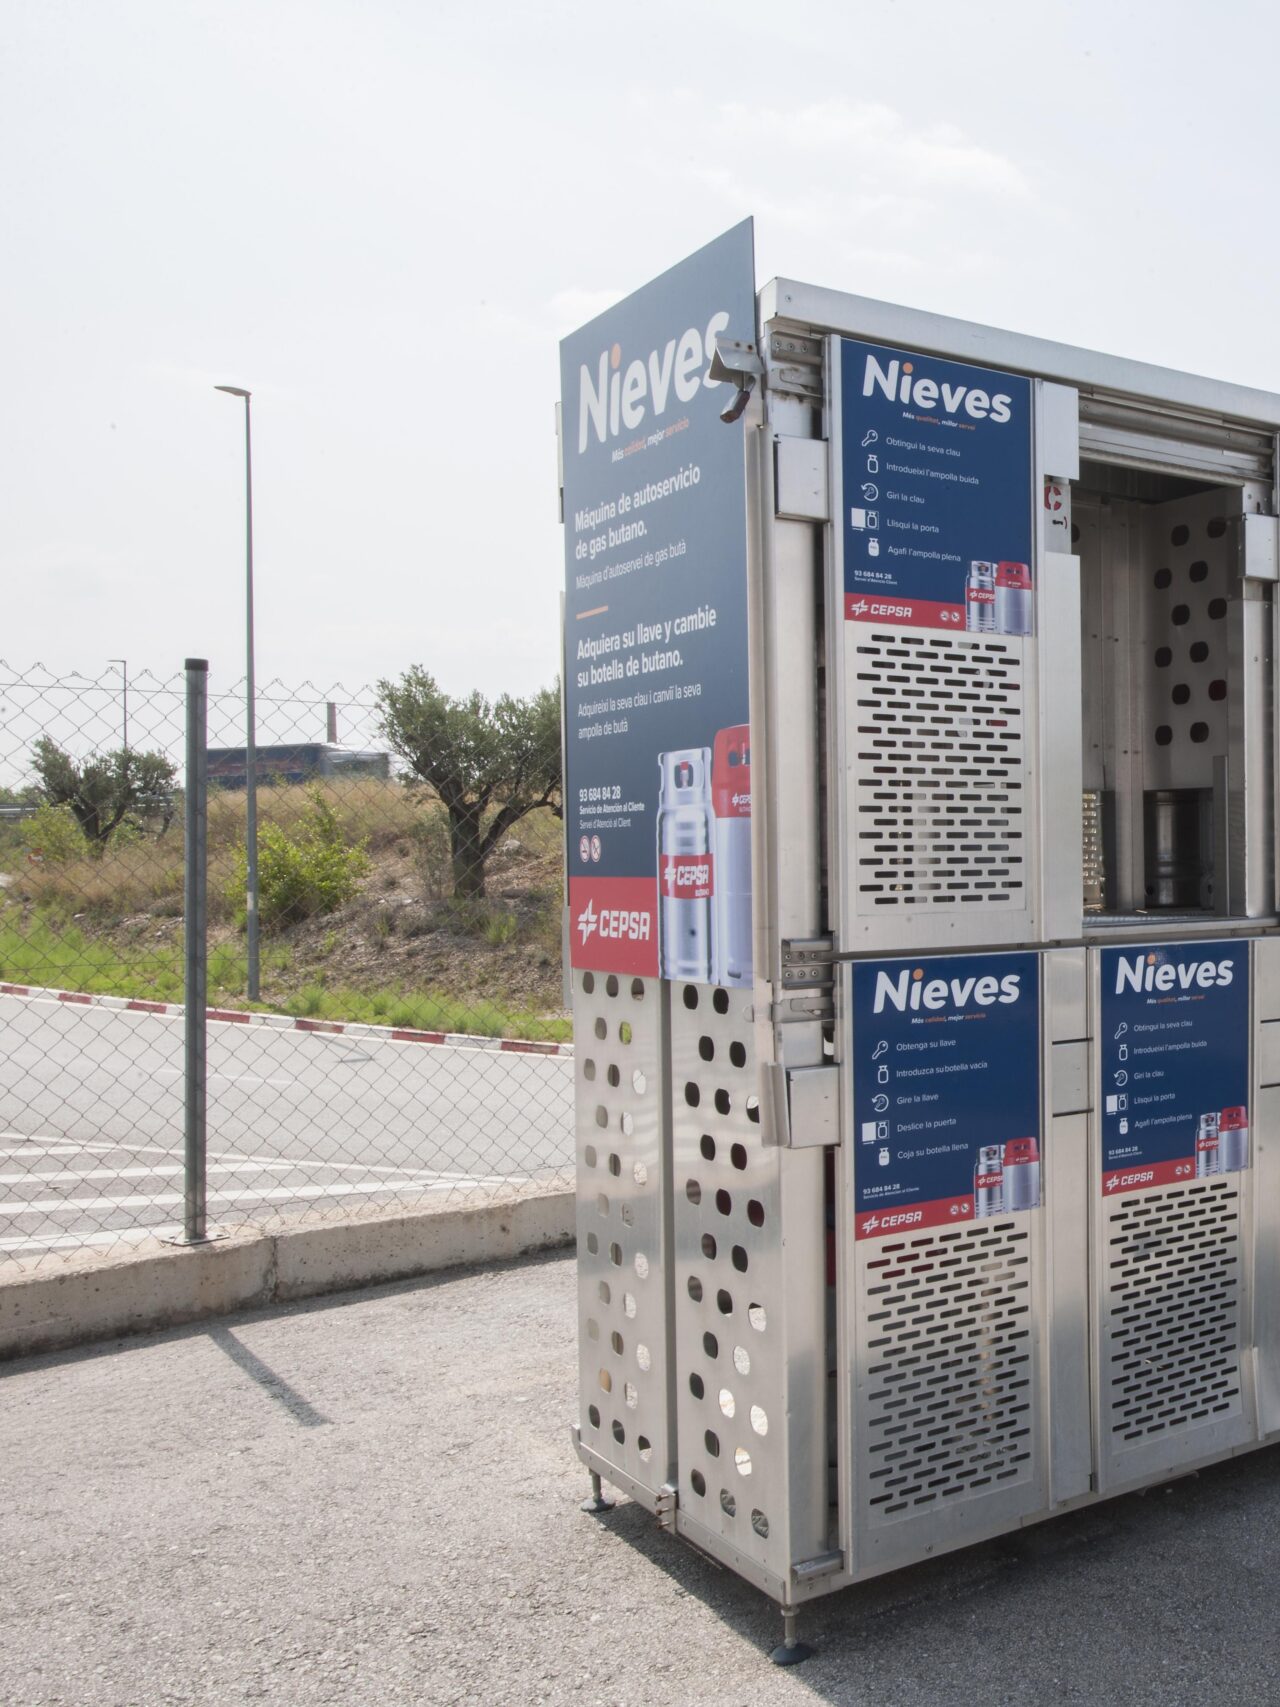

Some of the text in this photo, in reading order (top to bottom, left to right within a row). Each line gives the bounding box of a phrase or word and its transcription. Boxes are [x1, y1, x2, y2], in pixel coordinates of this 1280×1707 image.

[579, 312, 729, 454] Nieves
[863, 355, 1012, 423] Nieves
[886, 436, 961, 457] Obtingui la seva clau
[886, 463, 979, 485] Introdueixi l'ampolla buida
[575, 463, 700, 532] Máquina de autoservicio
[887, 491, 925, 504] Giri la clau
[887, 519, 939, 533] Llisqui la porta
[576, 520, 647, 560] de gas butano.
[644, 551, 654, 567] de
[655, 548, 668, 567] gas
[670, 539, 686, 558] butà
[888, 545, 961, 562] Agafi l'ampolla plena
[871, 604, 912, 618] CEPSA
[577, 604, 716, 661] Adquiera su llave y cambie
[578, 650, 683, 687] su botella de butano.
[610, 699, 615, 712] la
[617, 697, 632, 710] seva
[634, 692, 648, 707] clau
[649, 690, 651, 704] i
[675, 685, 682, 699] la
[683, 683, 701, 698] seva
[579, 723, 602, 740] ampolla
[604, 719, 612, 735] de
[579, 786, 621, 801] 93 684 84 28
[579, 802, 645, 815] Servicio de Atención al Cliente
[677, 865, 708, 885] CEPSA
[600, 910, 650, 940] CEPSA
[1116, 953, 1234, 995] Nieves
[873, 968, 1020, 1013] Nieves
[1134, 1023, 1159, 1032] Obtingui
[896, 1038, 956, 1051] Obtenga su llave
[1192, 1040, 1207, 1048] buida
[897, 1067, 934, 1078] Introduzca
[945, 1063, 968, 1072] botella
[970, 1061, 988, 1069] vacía
[1134, 1072, 1144, 1080] Giri
[1152, 1070, 1164, 1078] clau
[897, 1093, 938, 1105] Gire la llave
[1134, 1096, 1153, 1105] Llisqui
[1160, 1093, 1175, 1101] porta
[897, 1118, 956, 1132] Deslice la puerta
[898, 1143, 968, 1160] Coja su botella llena
[1121, 1171, 1153, 1186] CEPSA
[881, 1211, 922, 1228] CEPSA
